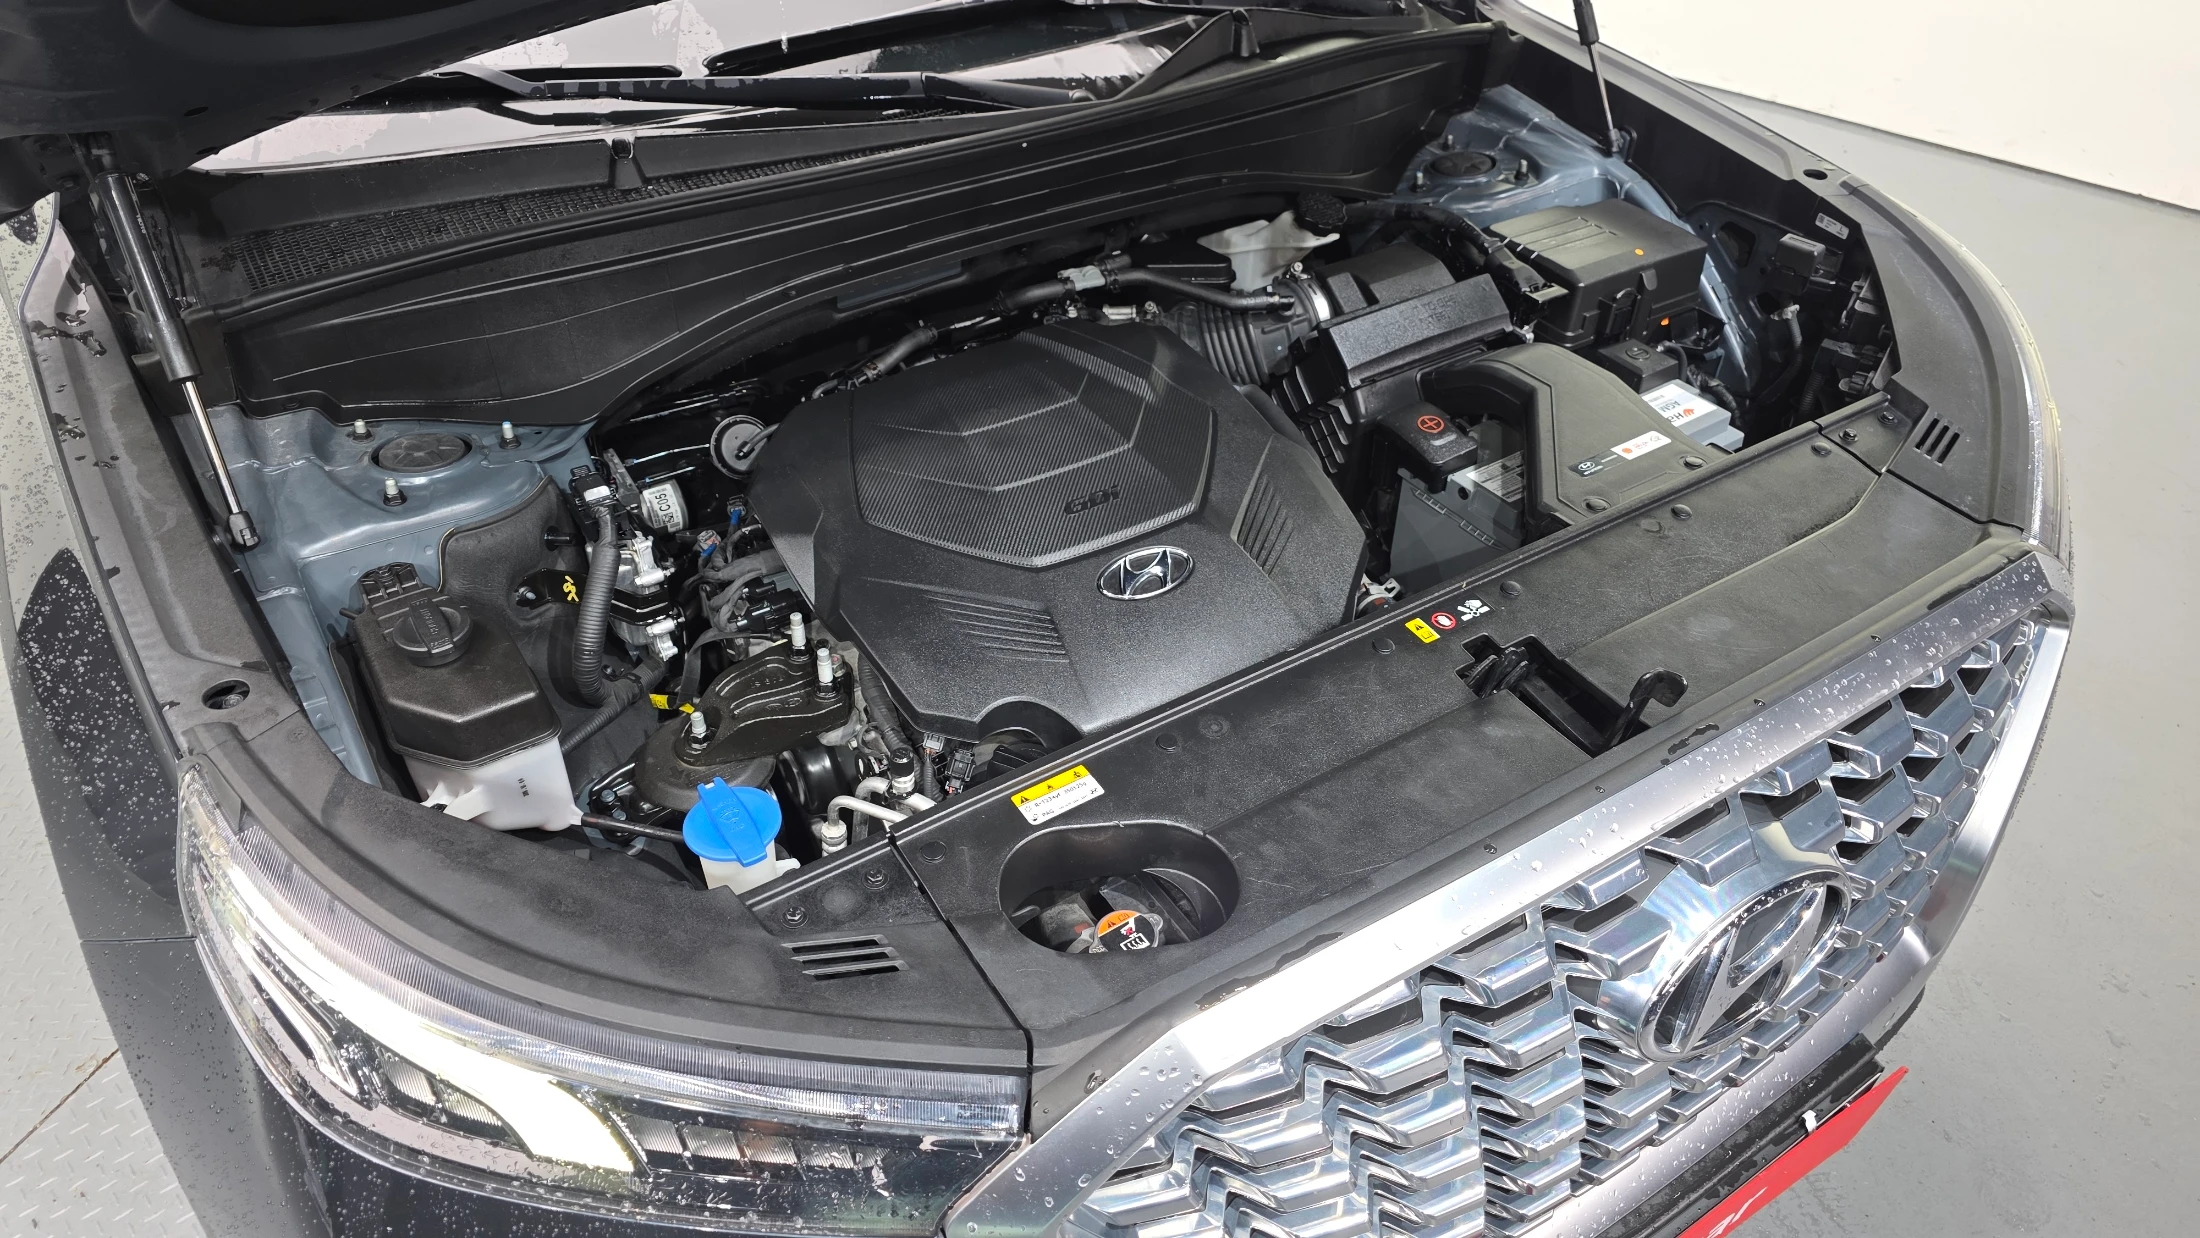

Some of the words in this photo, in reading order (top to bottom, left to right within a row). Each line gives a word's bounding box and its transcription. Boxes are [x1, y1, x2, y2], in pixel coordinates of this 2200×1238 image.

[1656, 401, 1681, 413] AGM
[654, 493, 671, 512] C05
[1064, 485, 1120, 515] GDi
